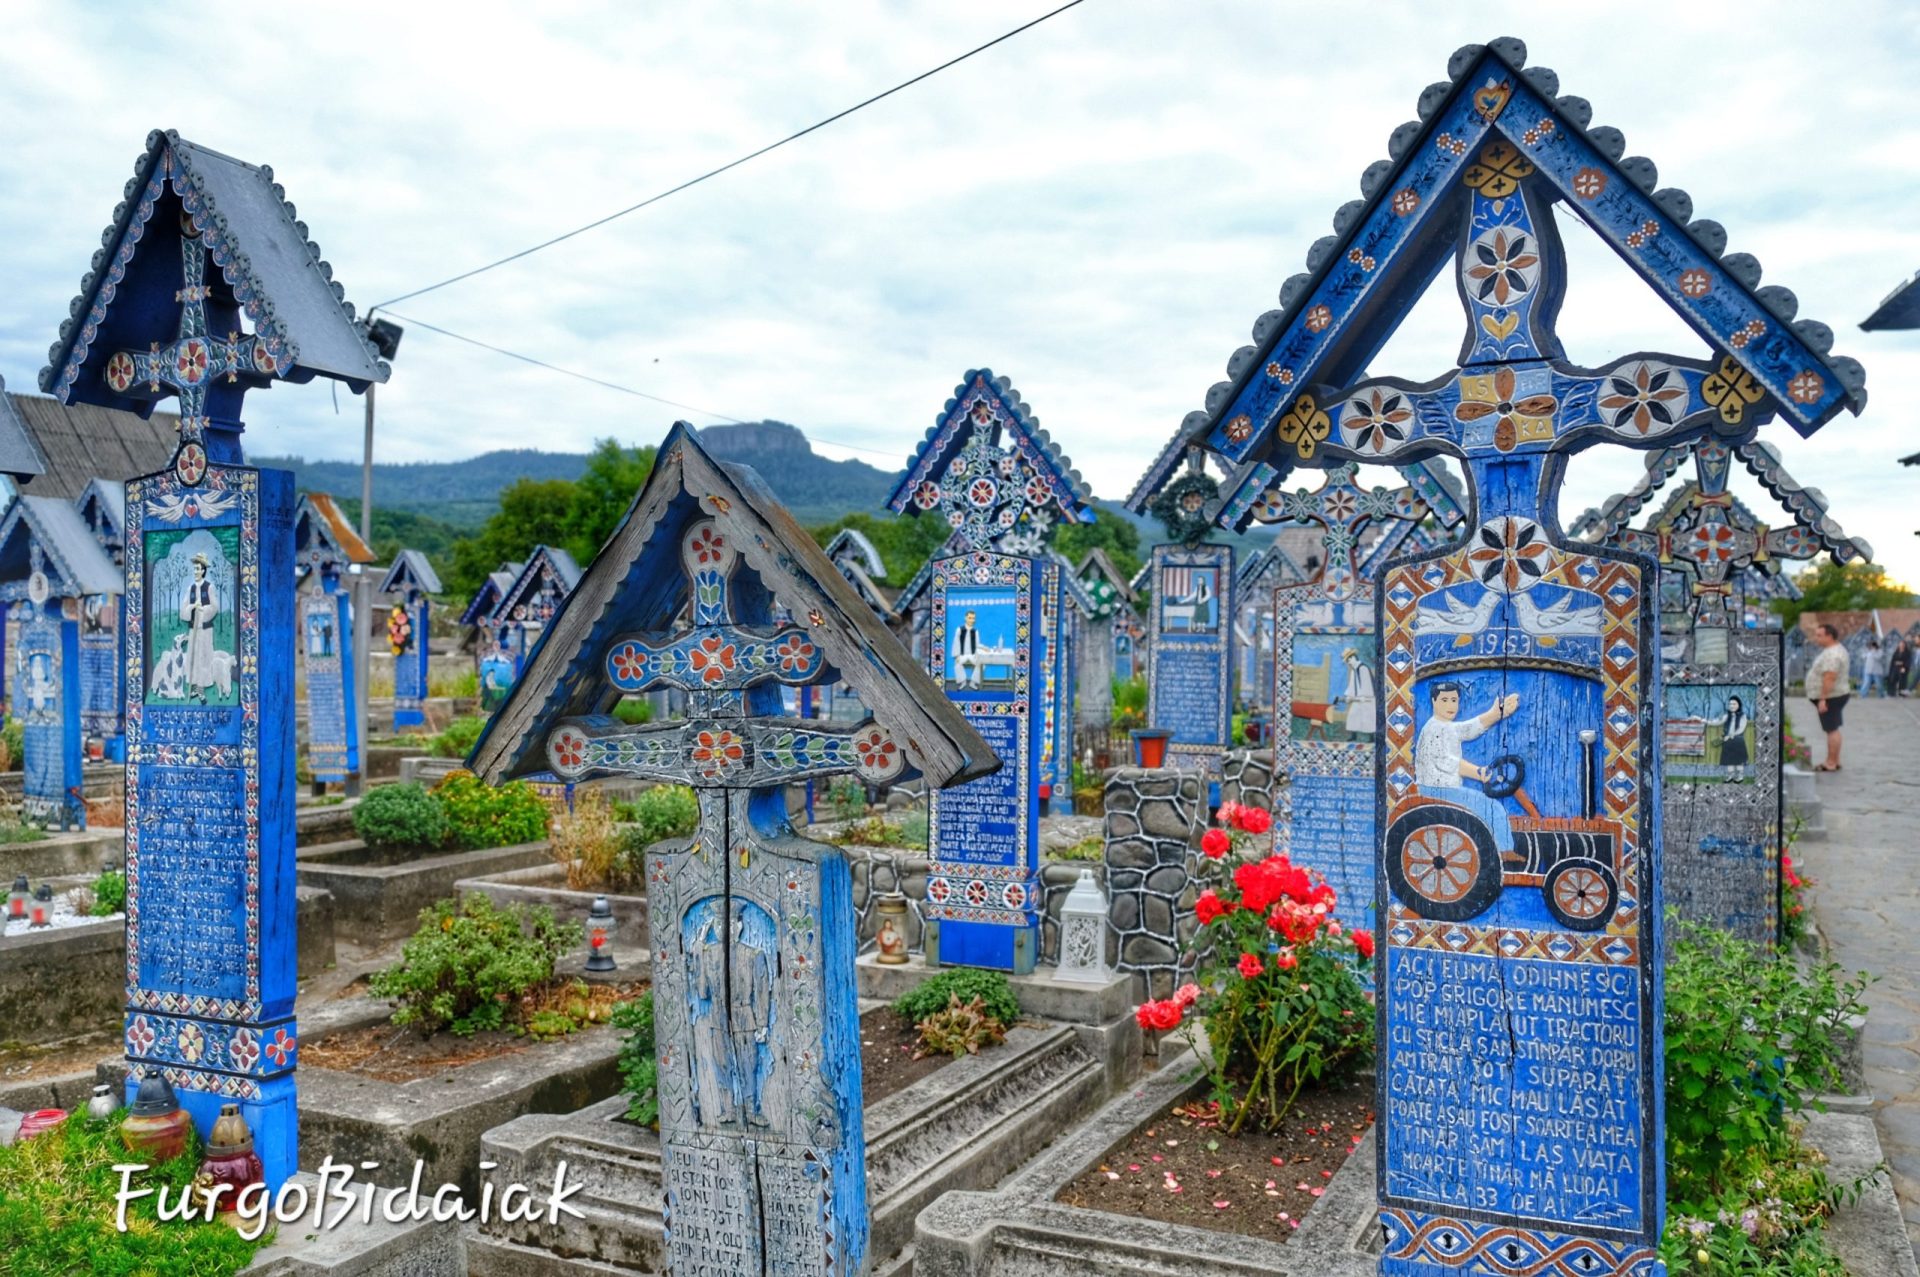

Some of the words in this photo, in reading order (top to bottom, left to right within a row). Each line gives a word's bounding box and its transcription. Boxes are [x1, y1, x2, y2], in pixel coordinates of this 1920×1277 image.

[1478, 633, 1531, 655] 1963
[1441, 984, 1527, 1011] GRIGORE
[1394, 1000, 1426, 1024] MIE
[1475, 1186, 1498, 1207] 33
